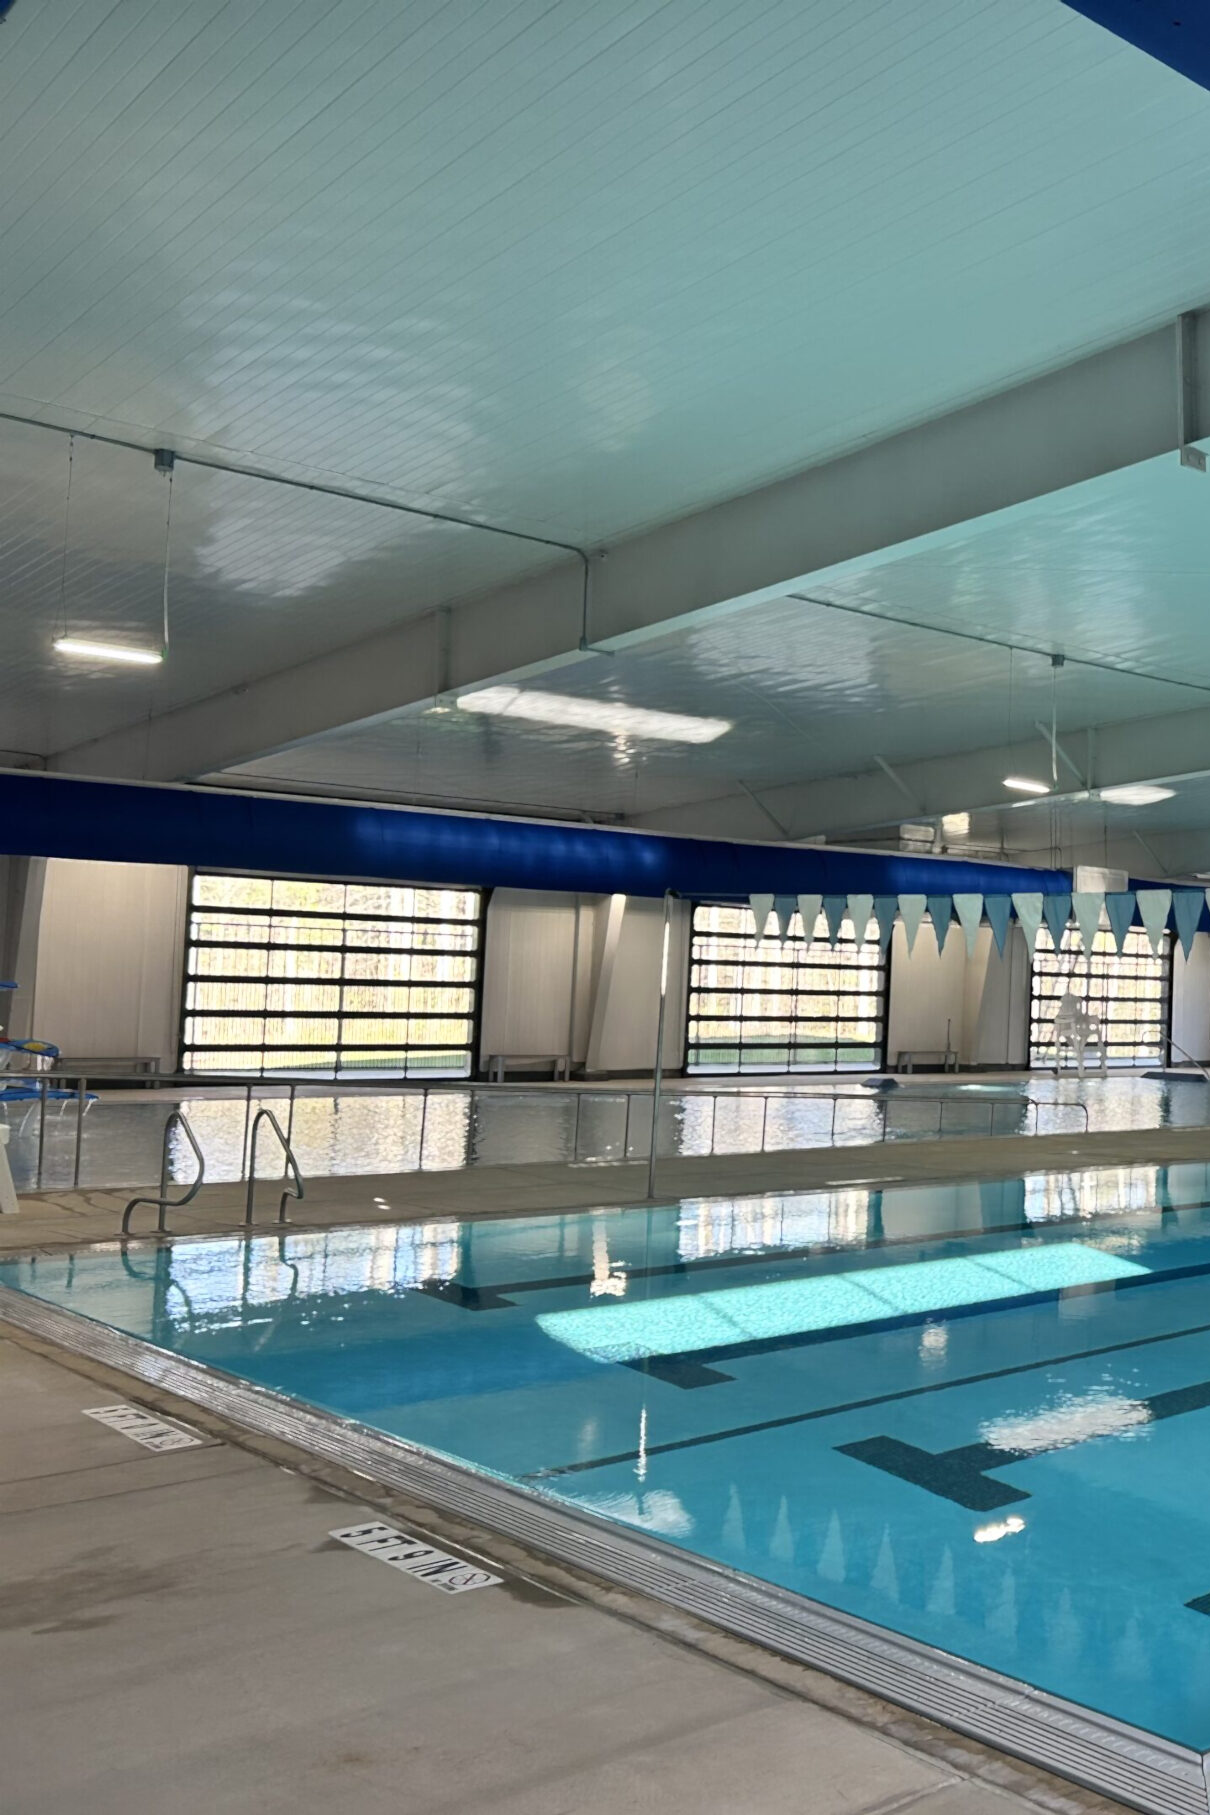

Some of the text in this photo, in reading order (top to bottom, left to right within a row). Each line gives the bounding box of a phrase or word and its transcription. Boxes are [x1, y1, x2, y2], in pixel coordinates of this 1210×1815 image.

[99, 1413, 148, 1423] FT
[340, 1526, 468, 1577] 5 FT 9 IN
